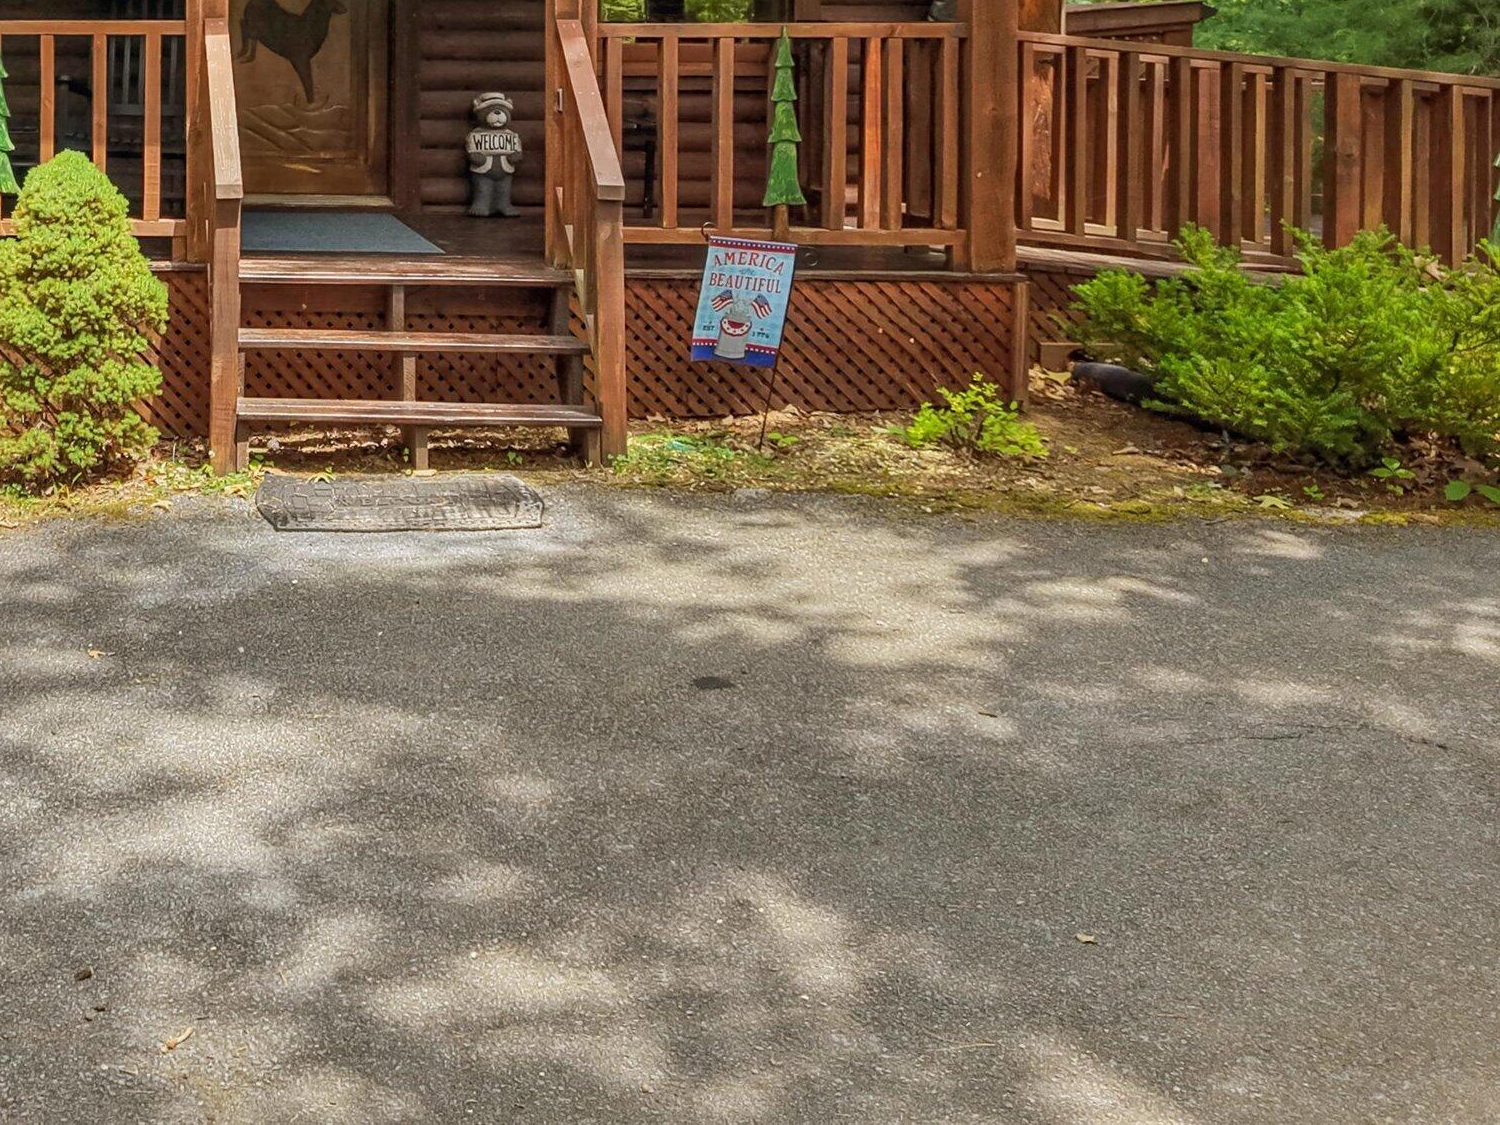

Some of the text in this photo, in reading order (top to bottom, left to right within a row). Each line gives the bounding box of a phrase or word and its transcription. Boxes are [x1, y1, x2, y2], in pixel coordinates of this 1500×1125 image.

[473, 134, 517, 151] WELCOME
[713, 252, 785, 276] AMERICA
[709, 272, 782, 294] BEAUTIFUL
